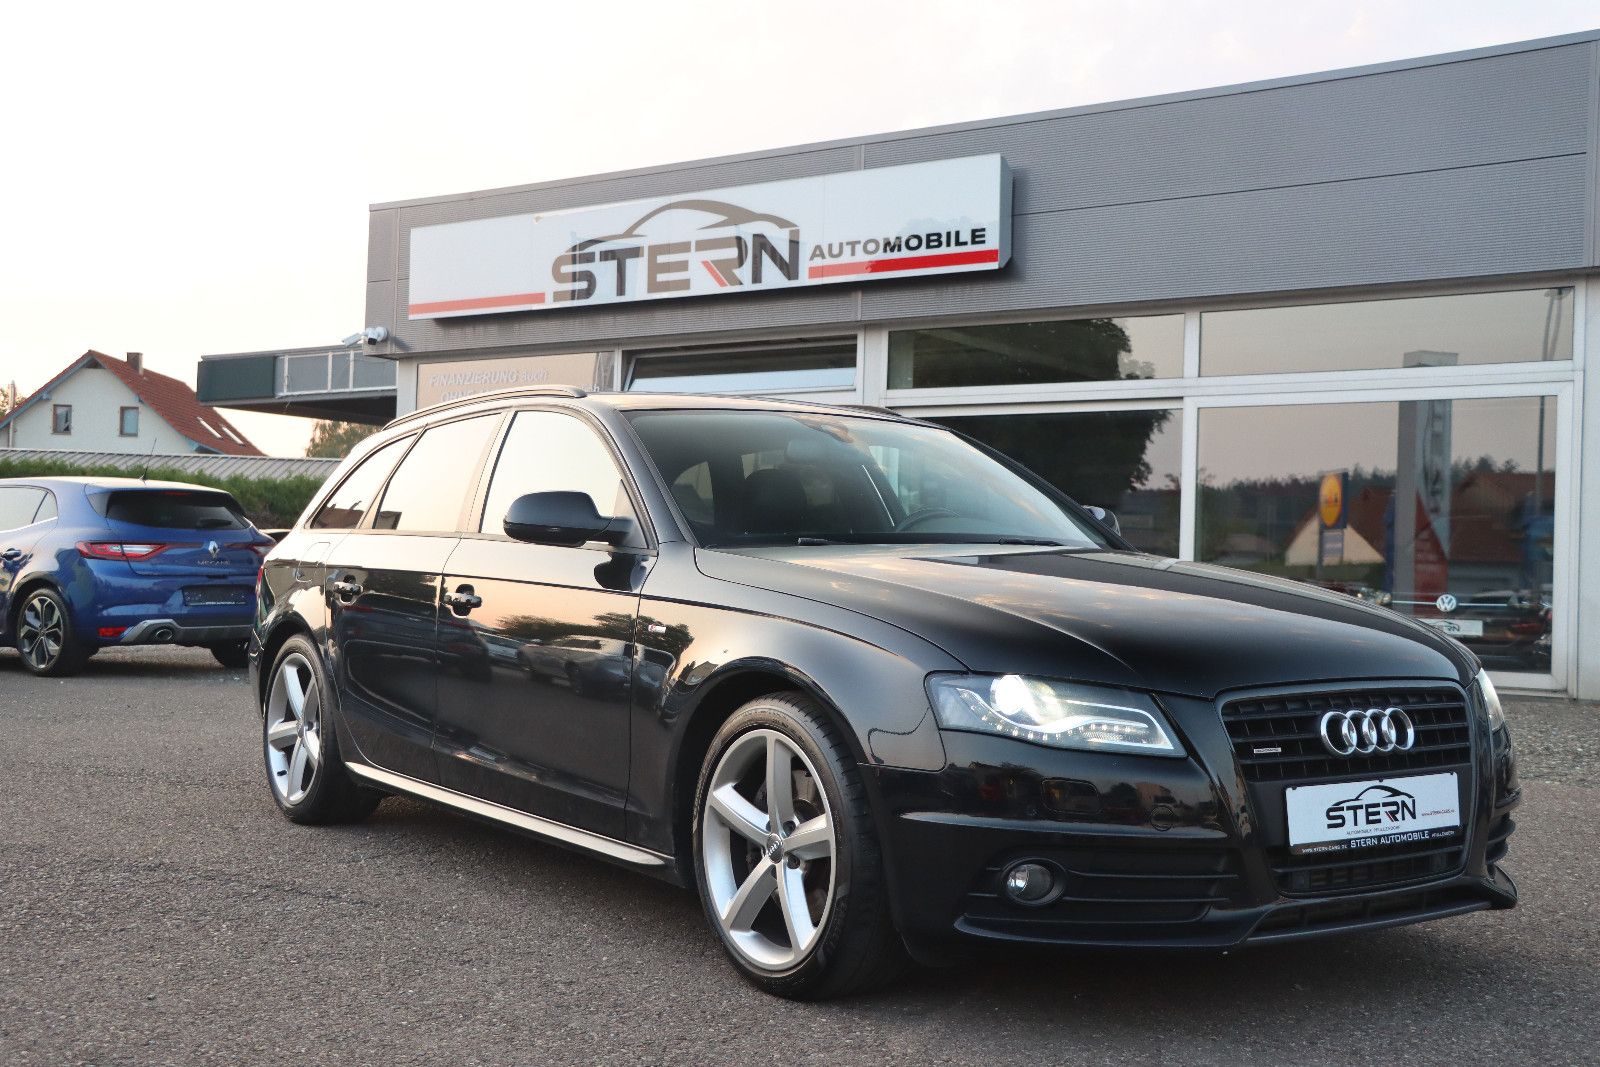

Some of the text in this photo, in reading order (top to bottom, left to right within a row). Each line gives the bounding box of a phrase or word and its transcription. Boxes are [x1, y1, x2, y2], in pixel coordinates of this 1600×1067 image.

[809, 228, 987, 261] AUTOMOBILE
[551, 228, 800, 302] STERN
[429, 369, 547, 386] FINANZIERUNG auch
[1326, 798, 1416, 829] STERN
[1350, 837, 1378, 848] STERN
[1380, 831, 1430, 846] AUTOMOBILE
